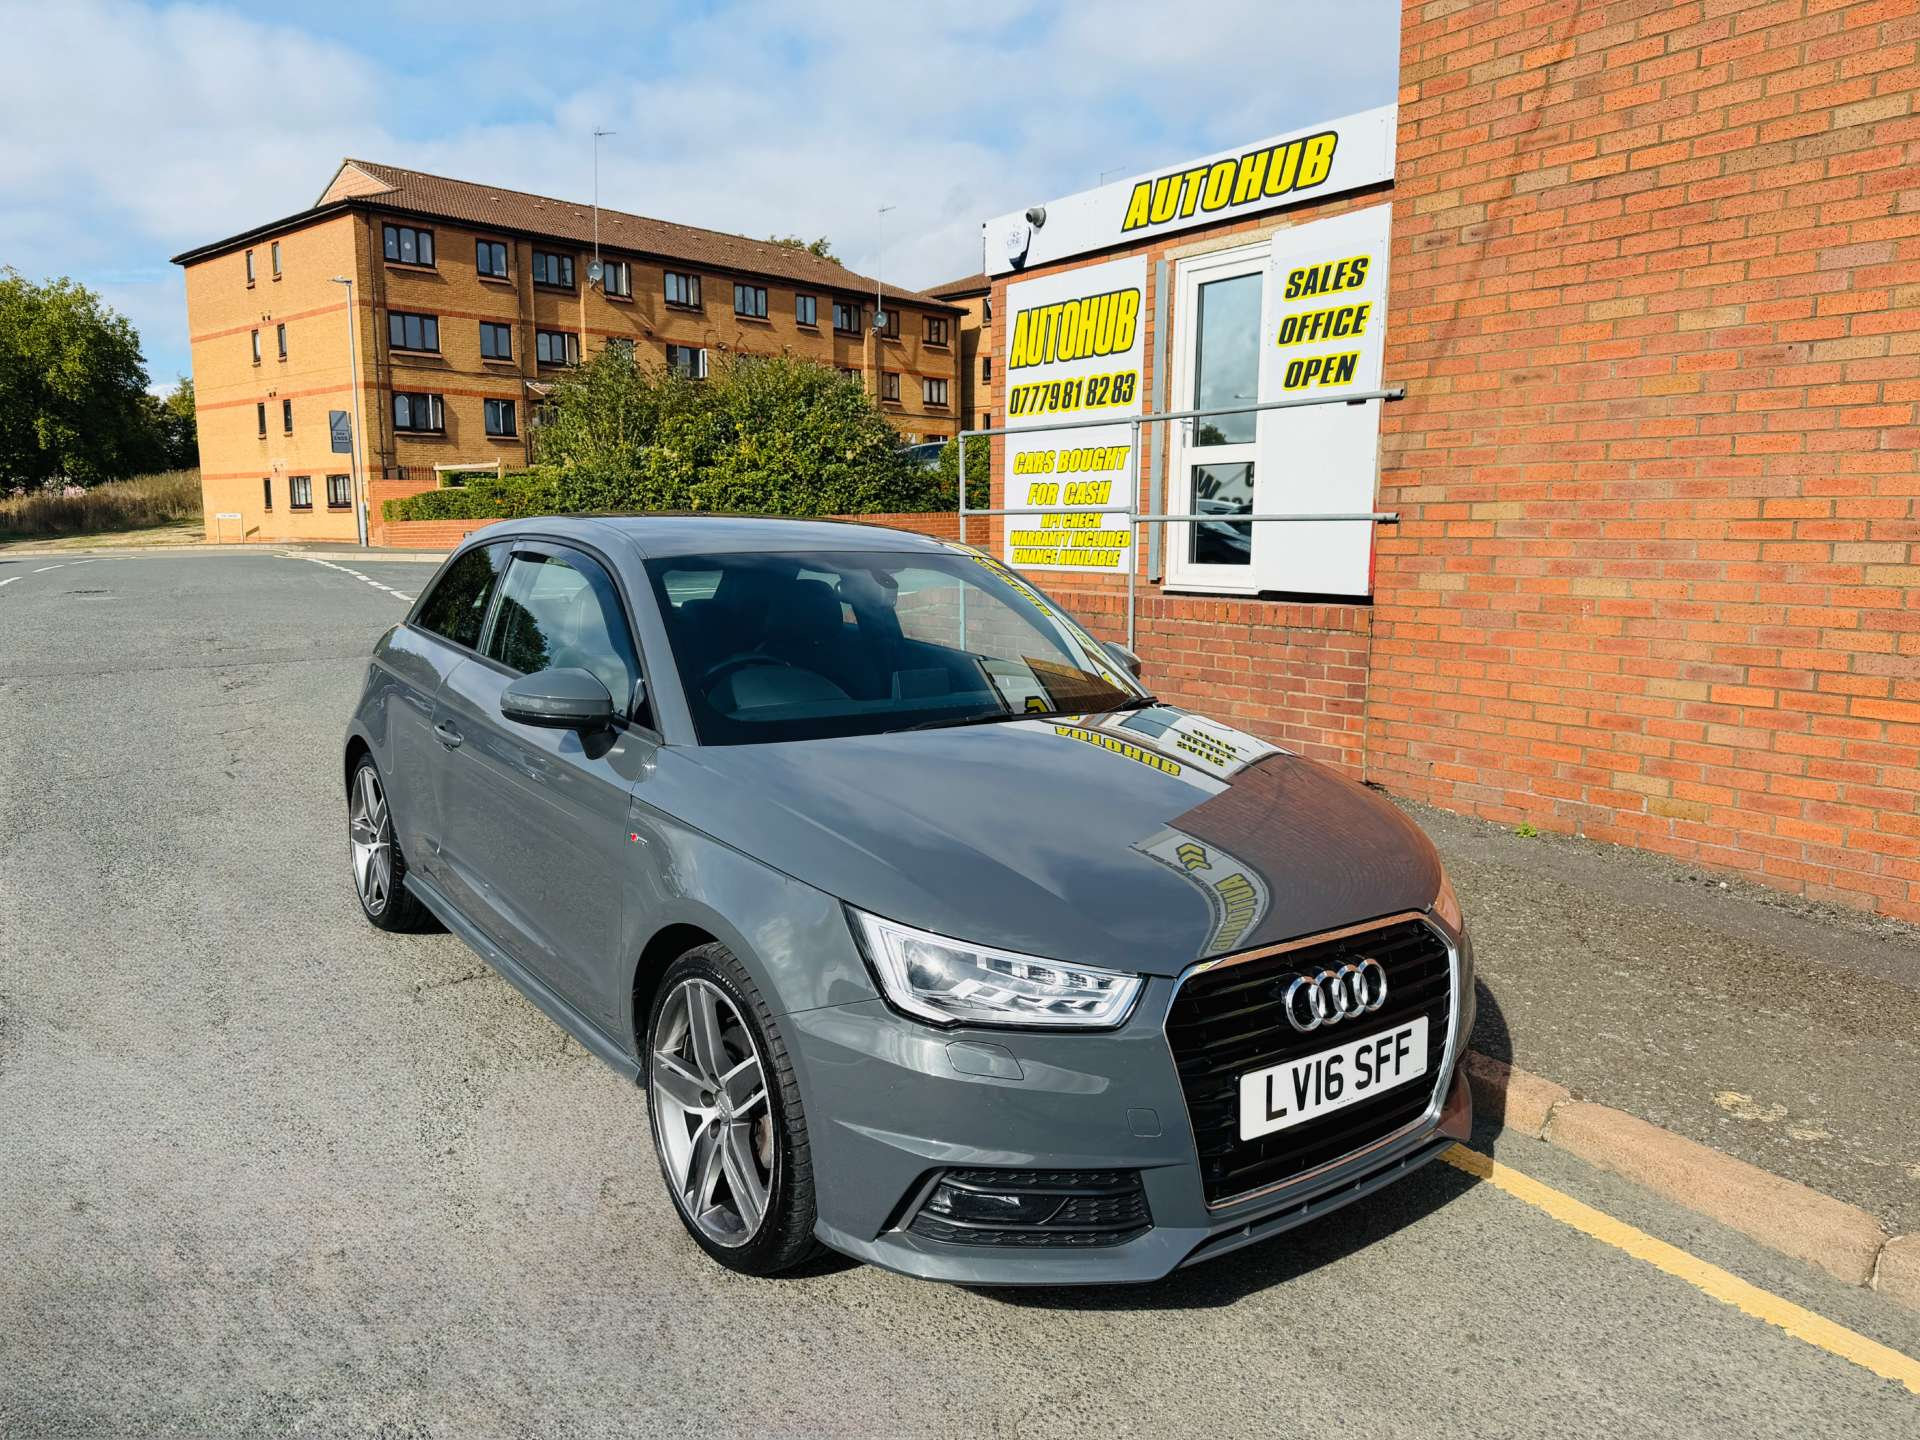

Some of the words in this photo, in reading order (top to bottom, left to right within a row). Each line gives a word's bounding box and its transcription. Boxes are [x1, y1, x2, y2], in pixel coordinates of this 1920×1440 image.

[1121, 131, 1338, 232] AUTOHUB
[1284, 255, 1371, 300] SALES
[1009, 288, 1140, 370] AUTOHUB
[1278, 303, 1373, 348] OFFICE
[1284, 352, 1359, 389] OPEN
[1013, 451, 1056, 475] CARS
[1056, 446, 1131, 473] BOUGHT
[1027, 482, 1059, 505] FOR
[1063, 480, 1112, 505] CASH
[1010, 530, 1071, 546] WARRANTY
[1070, 530, 1131, 547] INCLUDED
[1062, 512, 1103, 528] CHECK
[1012, 548, 1058, 564] FINANCE
[1056, 549, 1121, 567] AVAILABLE
[1265, 1054, 1344, 1122] LV16
[1355, 1028, 1412, 1090] SFF
